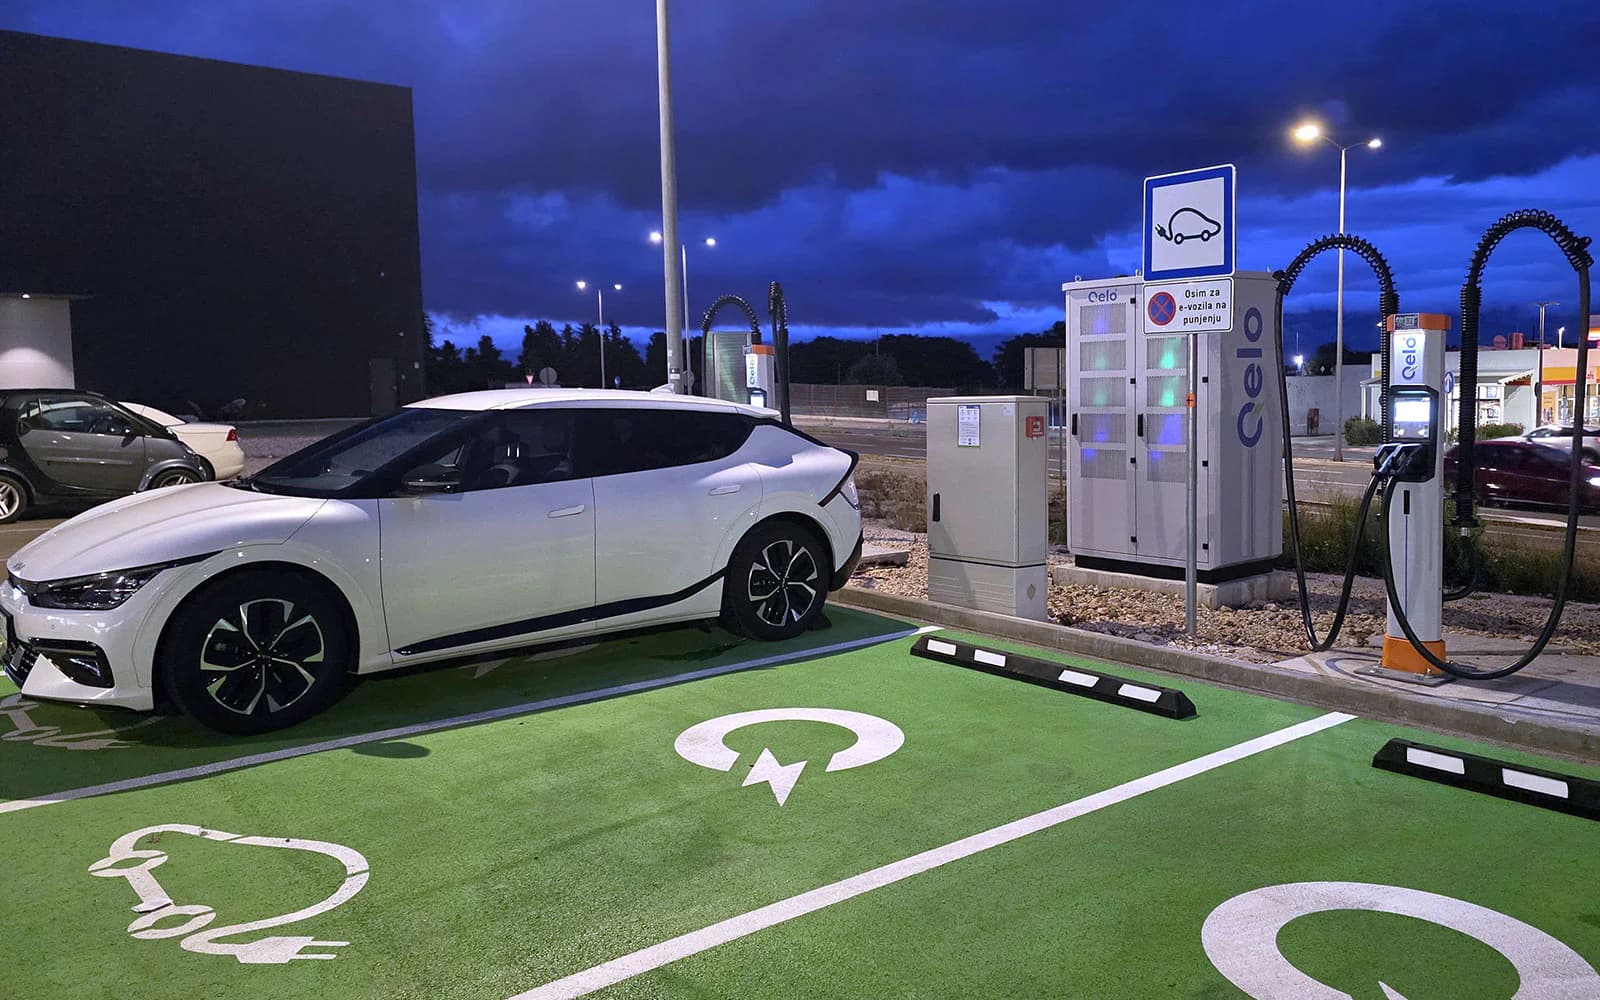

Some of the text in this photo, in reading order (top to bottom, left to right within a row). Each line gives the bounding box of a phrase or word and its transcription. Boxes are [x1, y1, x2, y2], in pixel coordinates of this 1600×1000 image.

[1185, 289, 1220, 298] Osim za
[1179, 301, 1212, 311] e-vozila
[1184, 314, 1221, 325] punjenju
